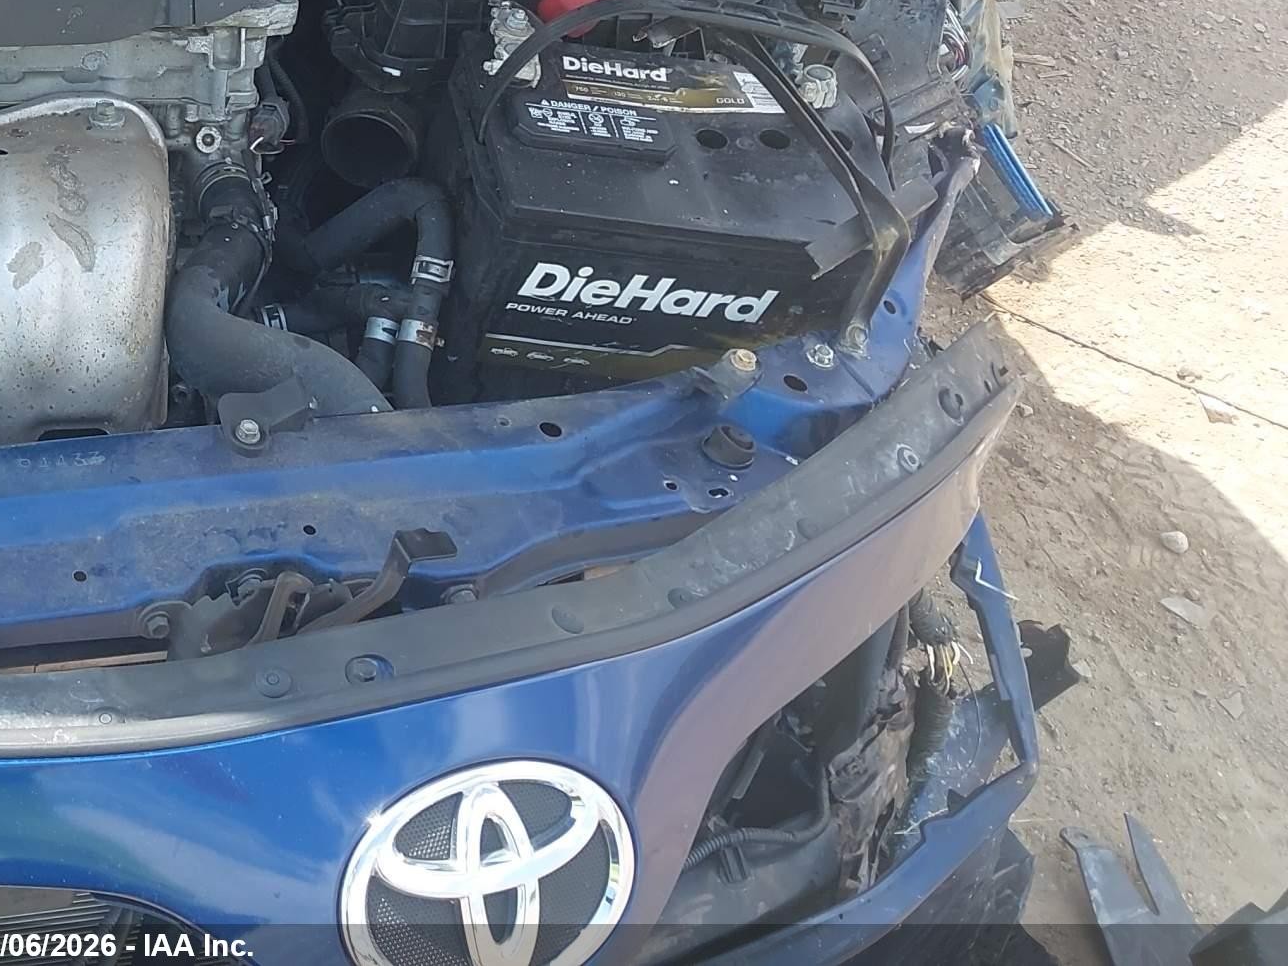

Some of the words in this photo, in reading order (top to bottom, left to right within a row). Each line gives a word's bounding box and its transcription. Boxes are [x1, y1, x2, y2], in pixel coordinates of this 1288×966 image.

[562, 55, 668, 83] DieHard
[551, 100, 591, 112] DANGER
[600, 105, 638, 117] POISON
[715, 96, 746, 105] GOLD
[517, 262, 780, 324] DieHard
[505, 302, 568, 317] POWER
[571, 310, 633, 325] AHEAD
